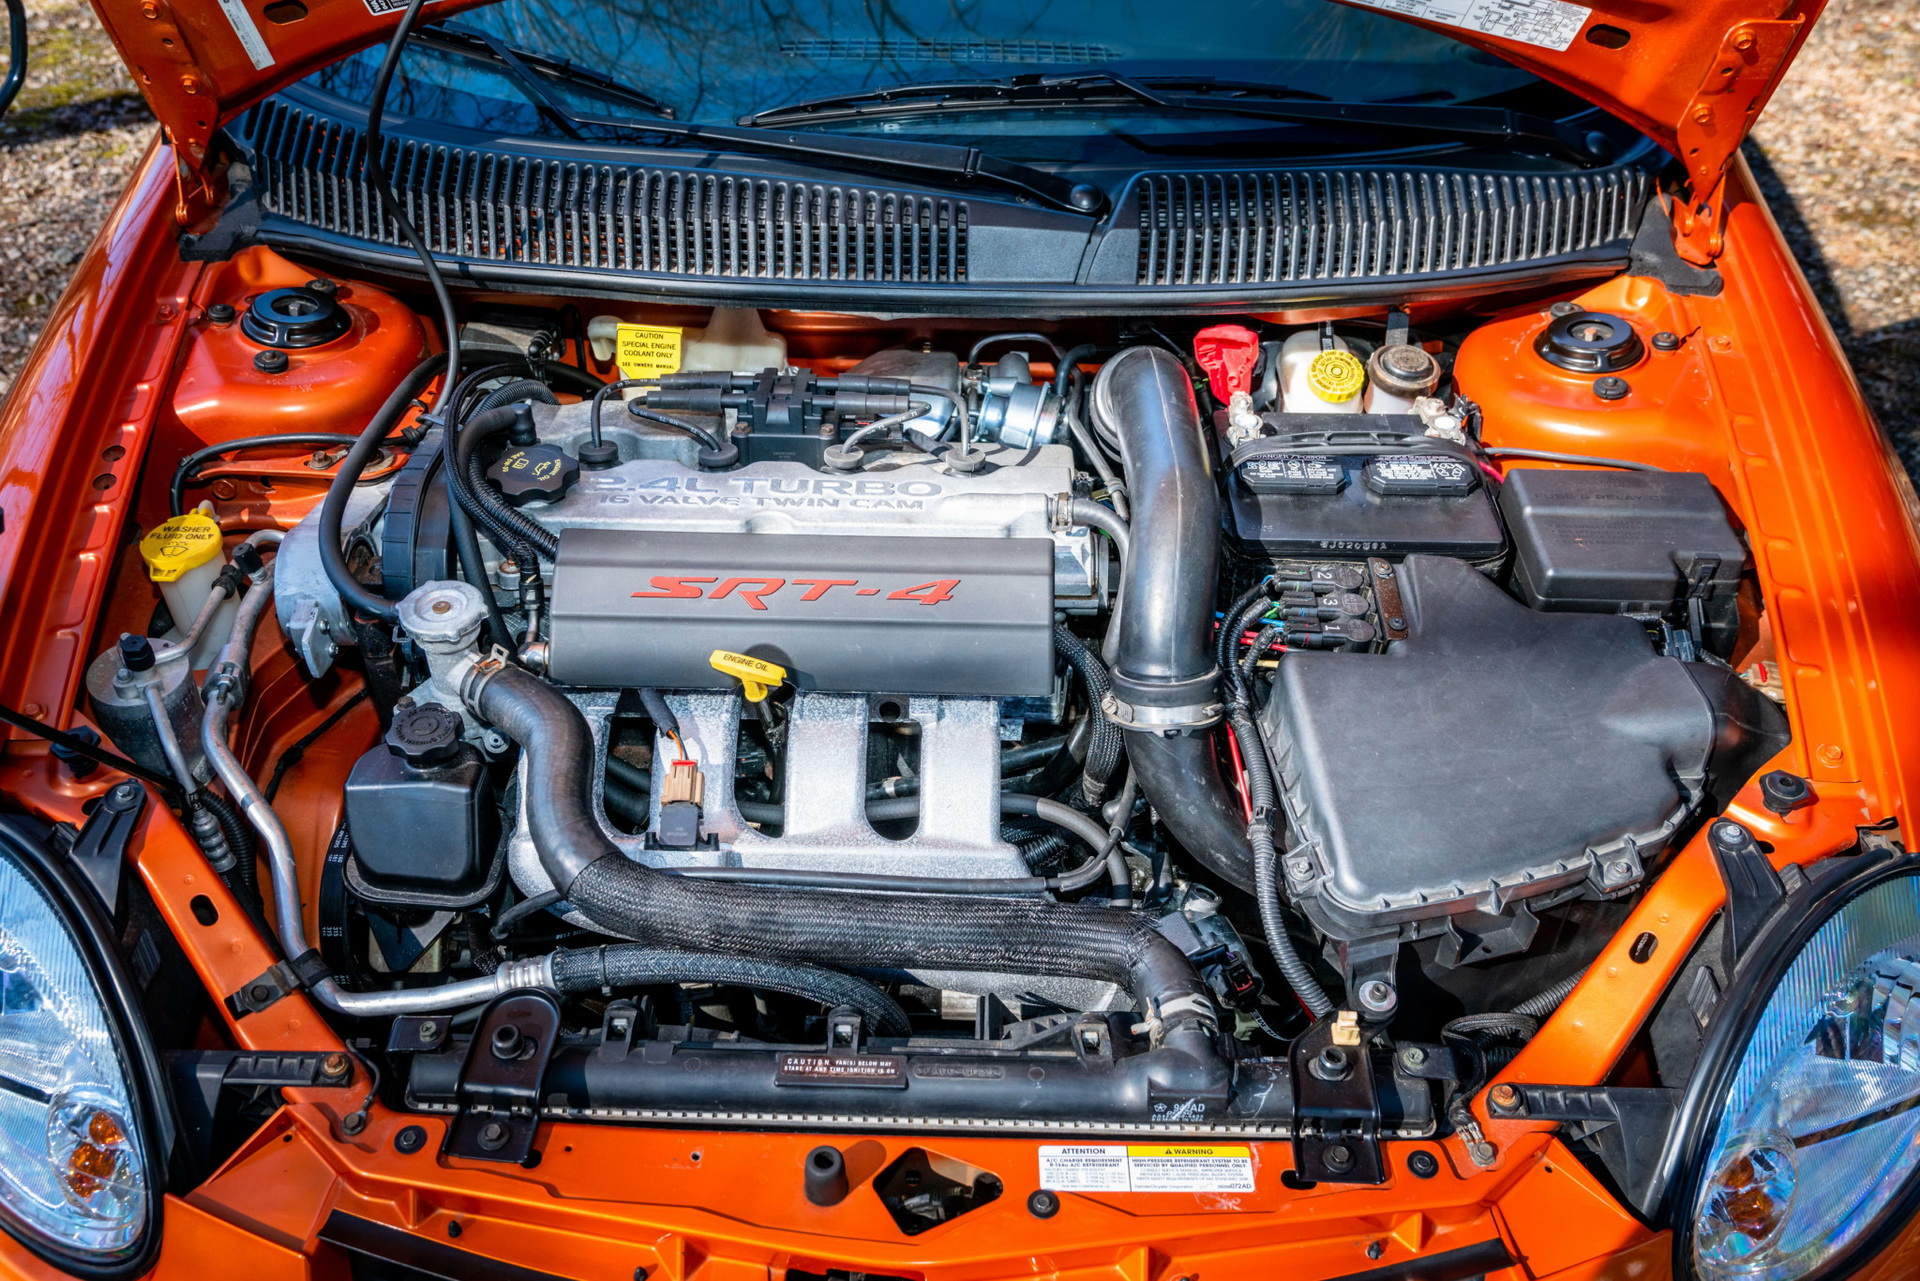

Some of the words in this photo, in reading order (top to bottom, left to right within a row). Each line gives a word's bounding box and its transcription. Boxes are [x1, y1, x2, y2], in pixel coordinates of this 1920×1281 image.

[622, 341, 649, 349] SPECIAL
[584, 476, 718, 494] 2.4L
[730, 477, 943, 497] TURBO
[600, 494, 630, 504] 16
[638, 494, 740, 506] VALVE
[751, 497, 840, 508] TWIN
[850, 498, 923, 510] CAM
[630, 576, 961, 611] SRT-4
[1323, 598, 1338, 606] 3
[723, 653, 755, 667] ENGINE
[755, 662, 768, 672] OIL
[787, 1058, 830, 1066] CAUTION
[1173, 1103, 1205, 1112] 9AD
